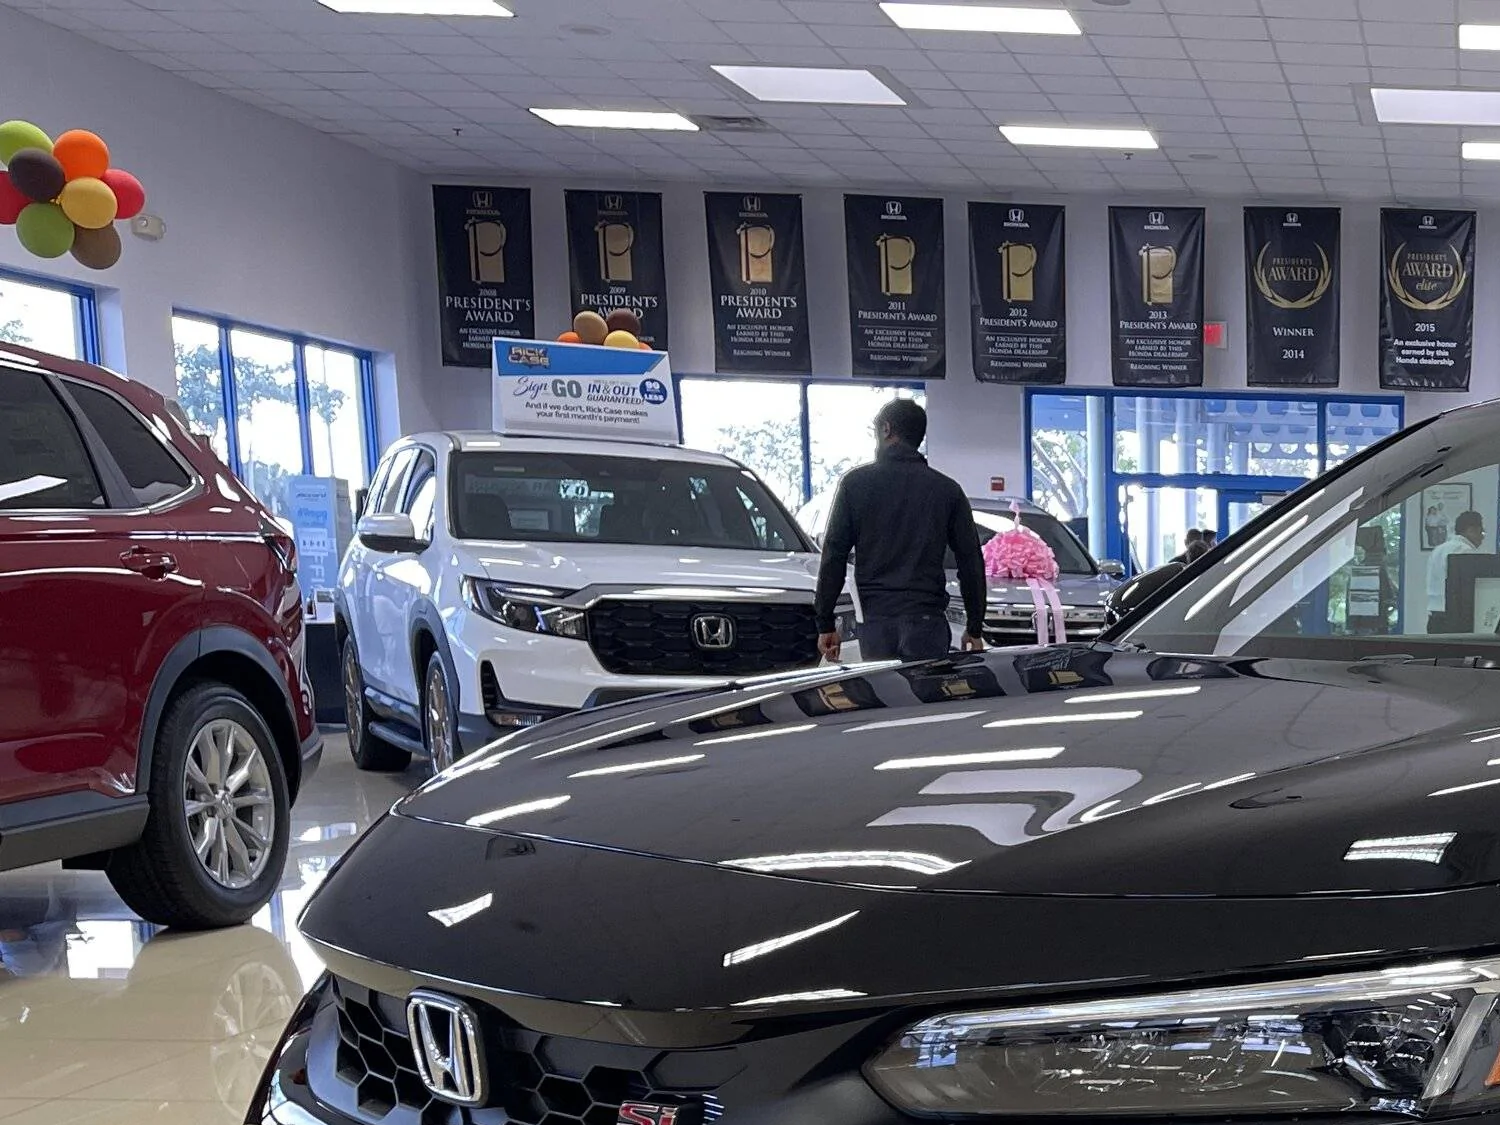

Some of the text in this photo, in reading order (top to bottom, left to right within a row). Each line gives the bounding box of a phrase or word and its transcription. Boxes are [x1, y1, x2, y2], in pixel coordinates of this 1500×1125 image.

[1269, 267, 1319, 281] AWARD
[1403, 262, 1453, 278] AWARD
[1416, 279, 1438, 292] elite
[446, 296, 531, 311] PRESIDENT'S
[580, 294, 658, 308] PRESIDENT'S
[720, 295, 797, 308] PRESIDENT'S
[888, 301, 905, 310] 2011
[465, 311, 513, 323] AWARD
[597, 307, 643, 319] AWD
[736, 308, 782, 319] AWARD
[858, 310, 937, 322] PRESIDENT'S AWARD
[1009, 308, 1027, 317] 2012
[1149, 311, 1167, 319] 2013
[980, 317, 1057, 328] PRESIDENT'S AWARD
[1120, 320, 1197, 330] PRESIDENT'S AWARD
[1415, 323, 1435, 332] 2015
[1272, 327, 1314, 337] WINNER
[1405, 339, 1435, 347] exclusive
[1437, 340, 1457, 348] honor
[511, 346, 545, 356] RICK
[1282, 349, 1304, 359] 2014
[1401, 348, 1425, 356] earned
[1426, 349, 1434, 357] by
[508, 355, 550, 366] CASE
[1419, 357, 1454, 366] dealership
[513, 376, 582, 400] Sign GO
[588, 383, 600, 394] IN
[602, 386, 612, 395] &
[613, 386, 638, 396] OUT
[586, 394, 645, 405] GUARANTEED!
[525, 401, 541, 410] And
[543, 402, 550, 410] if
[586, 405, 602, 413] Rick
[603, 407, 623, 415] Case
[624, 409, 648, 417] makes
[536, 410, 553, 419] your
[554, 410, 570, 419] first
[571, 412, 602, 422] month's
